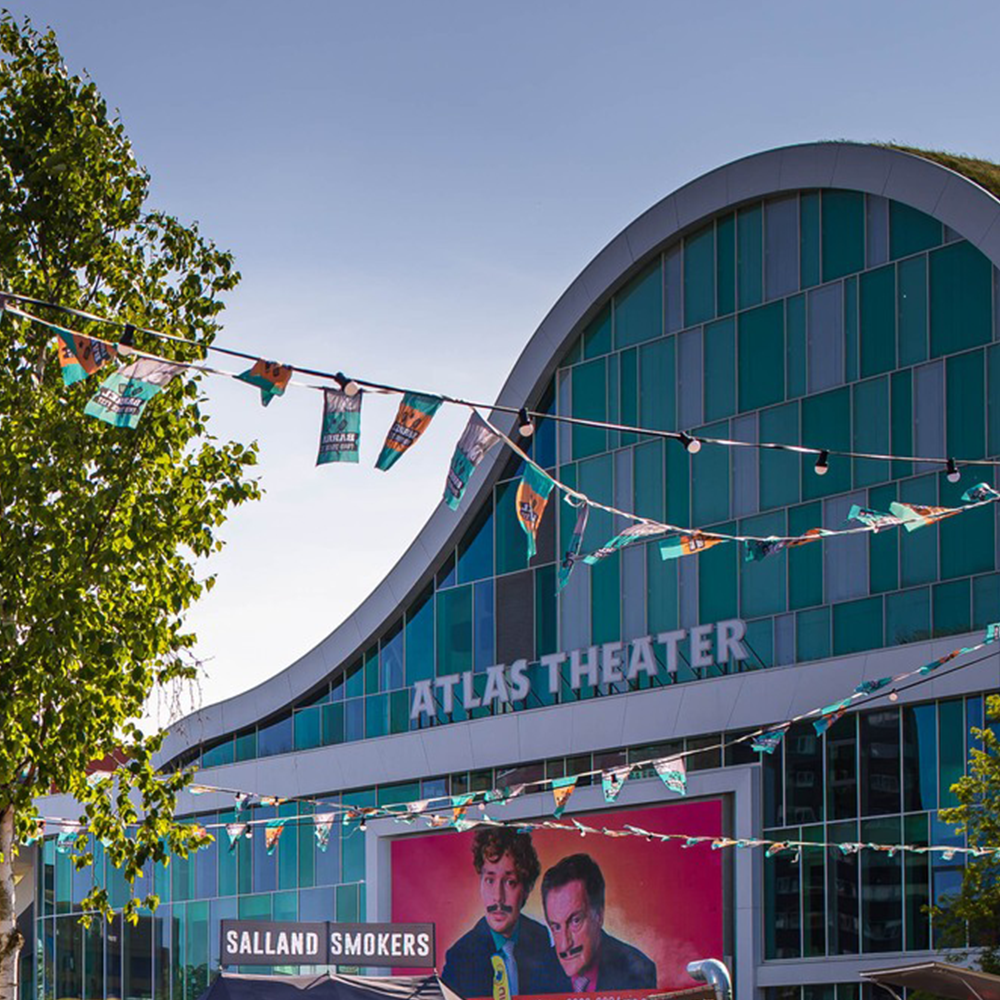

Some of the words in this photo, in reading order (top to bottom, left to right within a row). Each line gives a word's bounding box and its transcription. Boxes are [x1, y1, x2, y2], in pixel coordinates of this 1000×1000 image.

[410, 658, 531, 721] ATLAS
[540, 618, 749, 693] THEATER
[226, 930, 319, 956] SALLAND
[330, 931, 430, 957] SMOKERS
